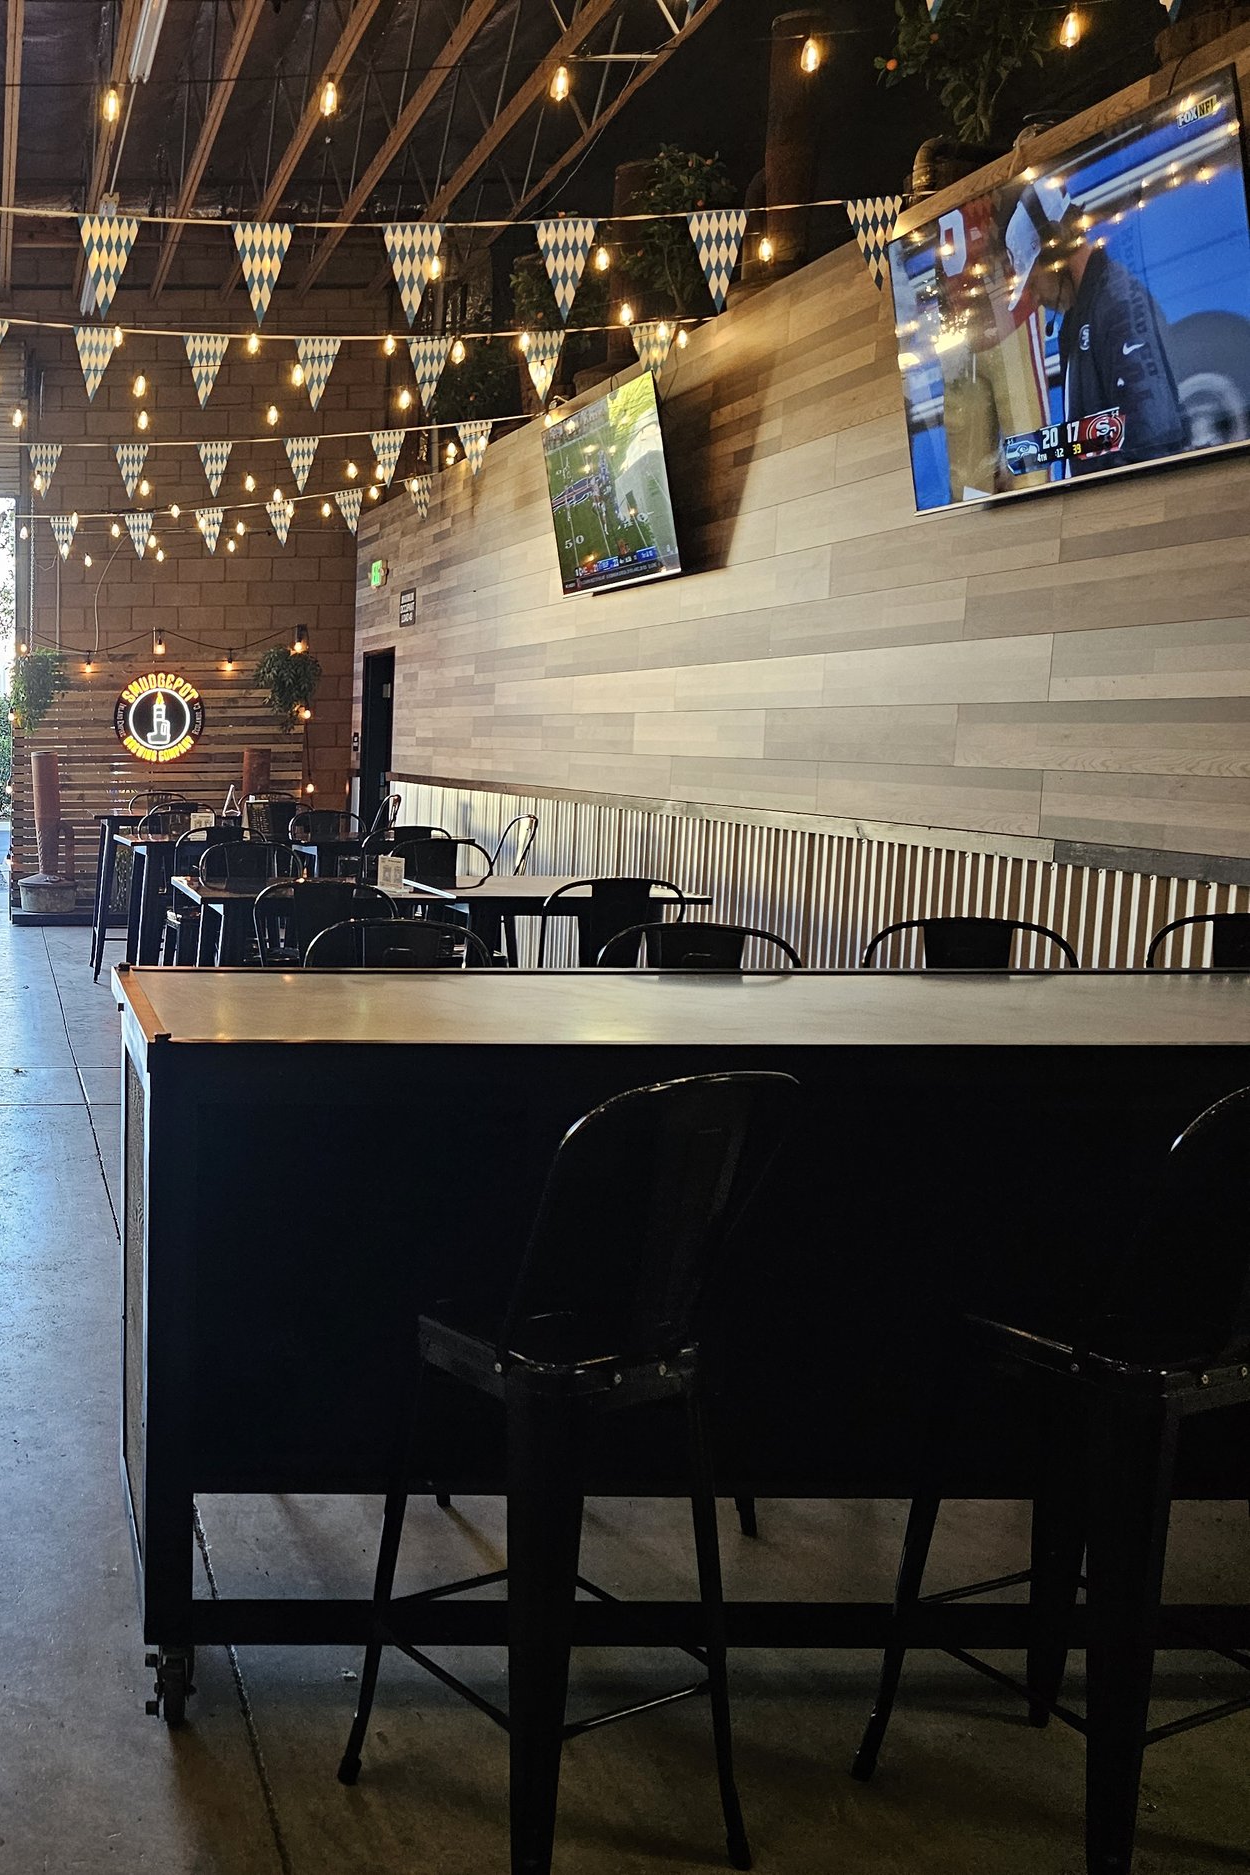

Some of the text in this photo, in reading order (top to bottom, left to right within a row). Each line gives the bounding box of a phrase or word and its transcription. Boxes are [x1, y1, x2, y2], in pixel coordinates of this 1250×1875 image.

[1176, 105, 1198, 127] FOX
[1042, 428, 1059, 450] 20
[1066, 421, 1080, 443] 17
[121, 672, 199, 704] SMUDGEPOT
